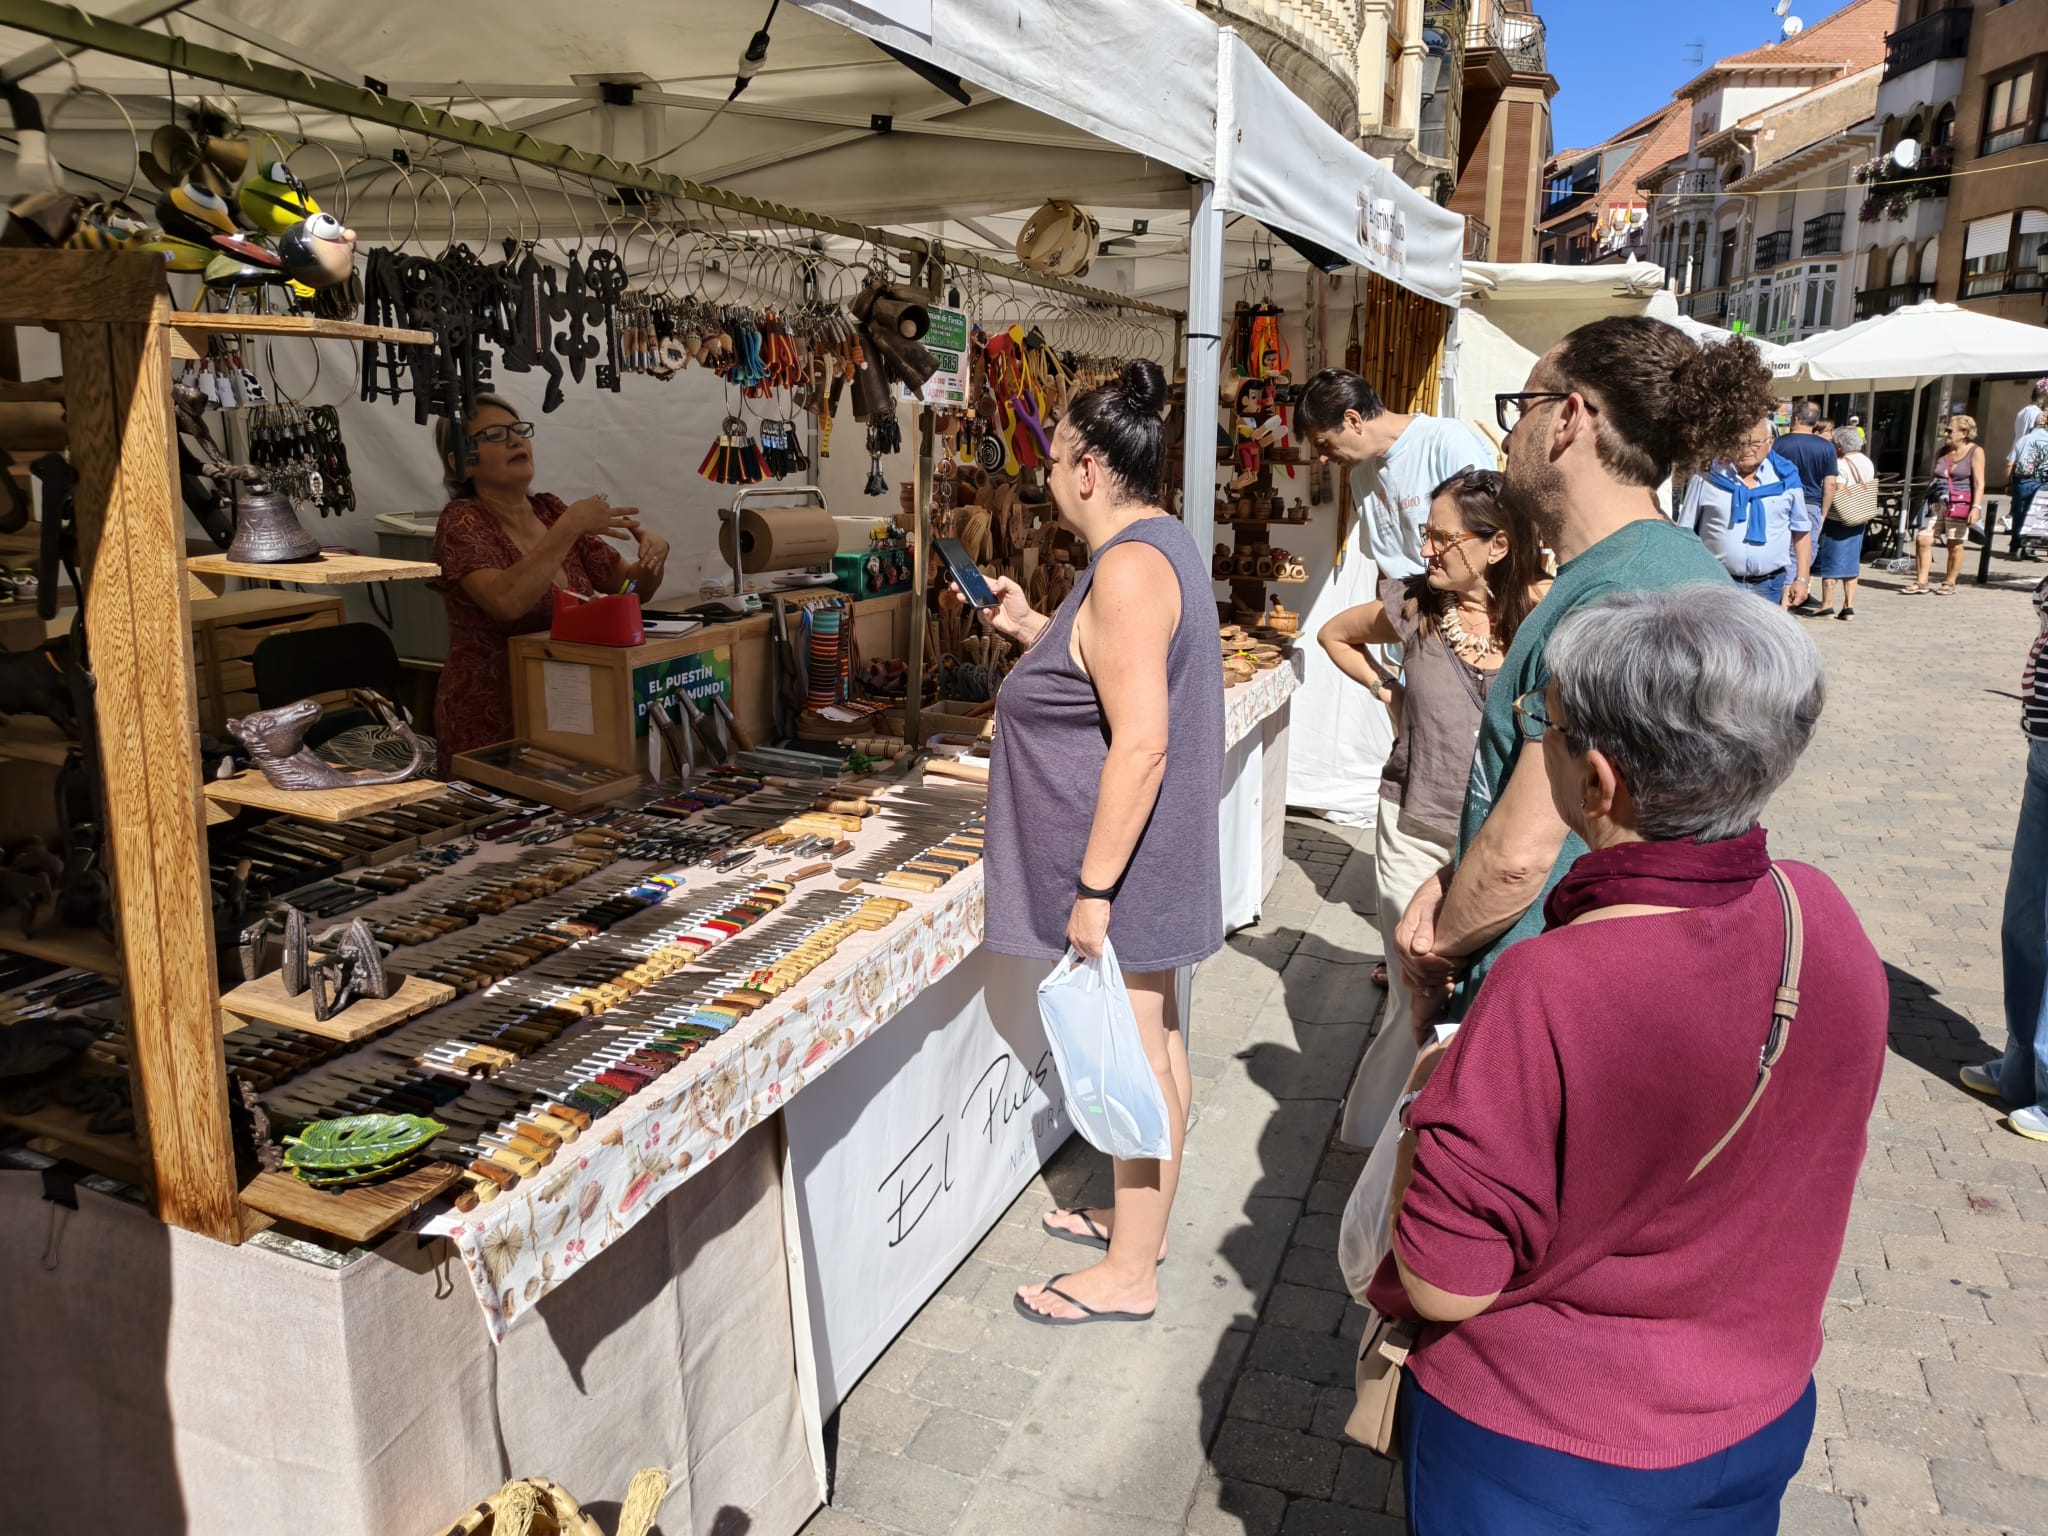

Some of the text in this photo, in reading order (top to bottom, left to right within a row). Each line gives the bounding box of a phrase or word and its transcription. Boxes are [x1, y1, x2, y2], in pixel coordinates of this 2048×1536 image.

[1765, 360, 1791, 370] ahou
[648, 664, 713, 695] EL PUESTÍN
[656, 680, 725, 709] ARMUNDI
[878, 1049, 1058, 1248] El Pues
[1009, 1097, 1066, 1175] NATURA
